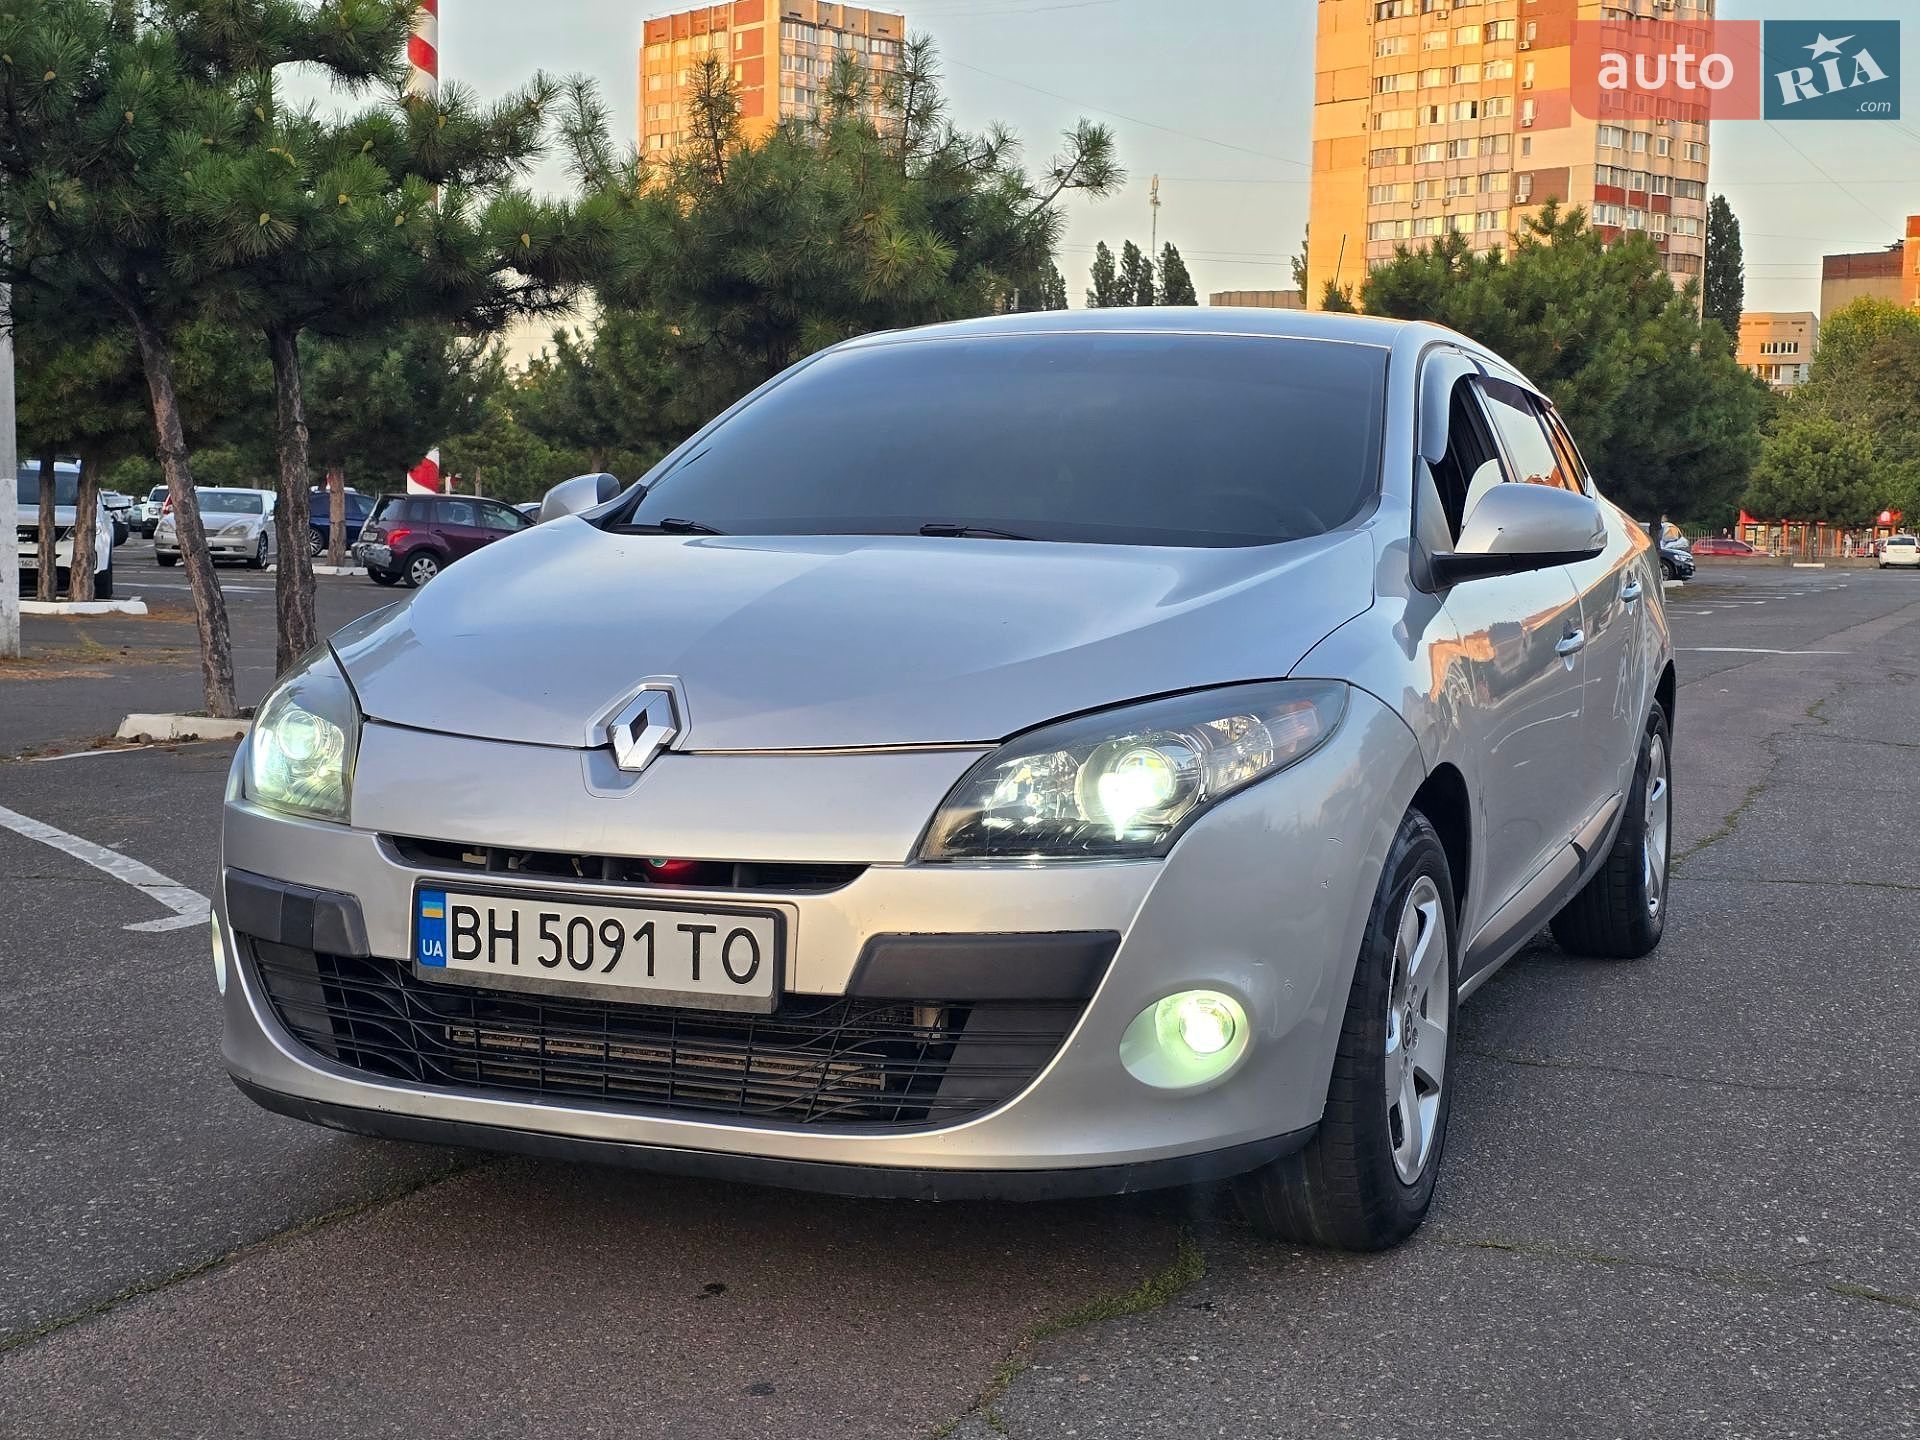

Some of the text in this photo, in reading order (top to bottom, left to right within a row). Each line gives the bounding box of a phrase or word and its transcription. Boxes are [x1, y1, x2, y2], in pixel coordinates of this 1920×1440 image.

[422, 939, 443, 957] UA
[452, 905, 761, 985] BH 5091 TO
